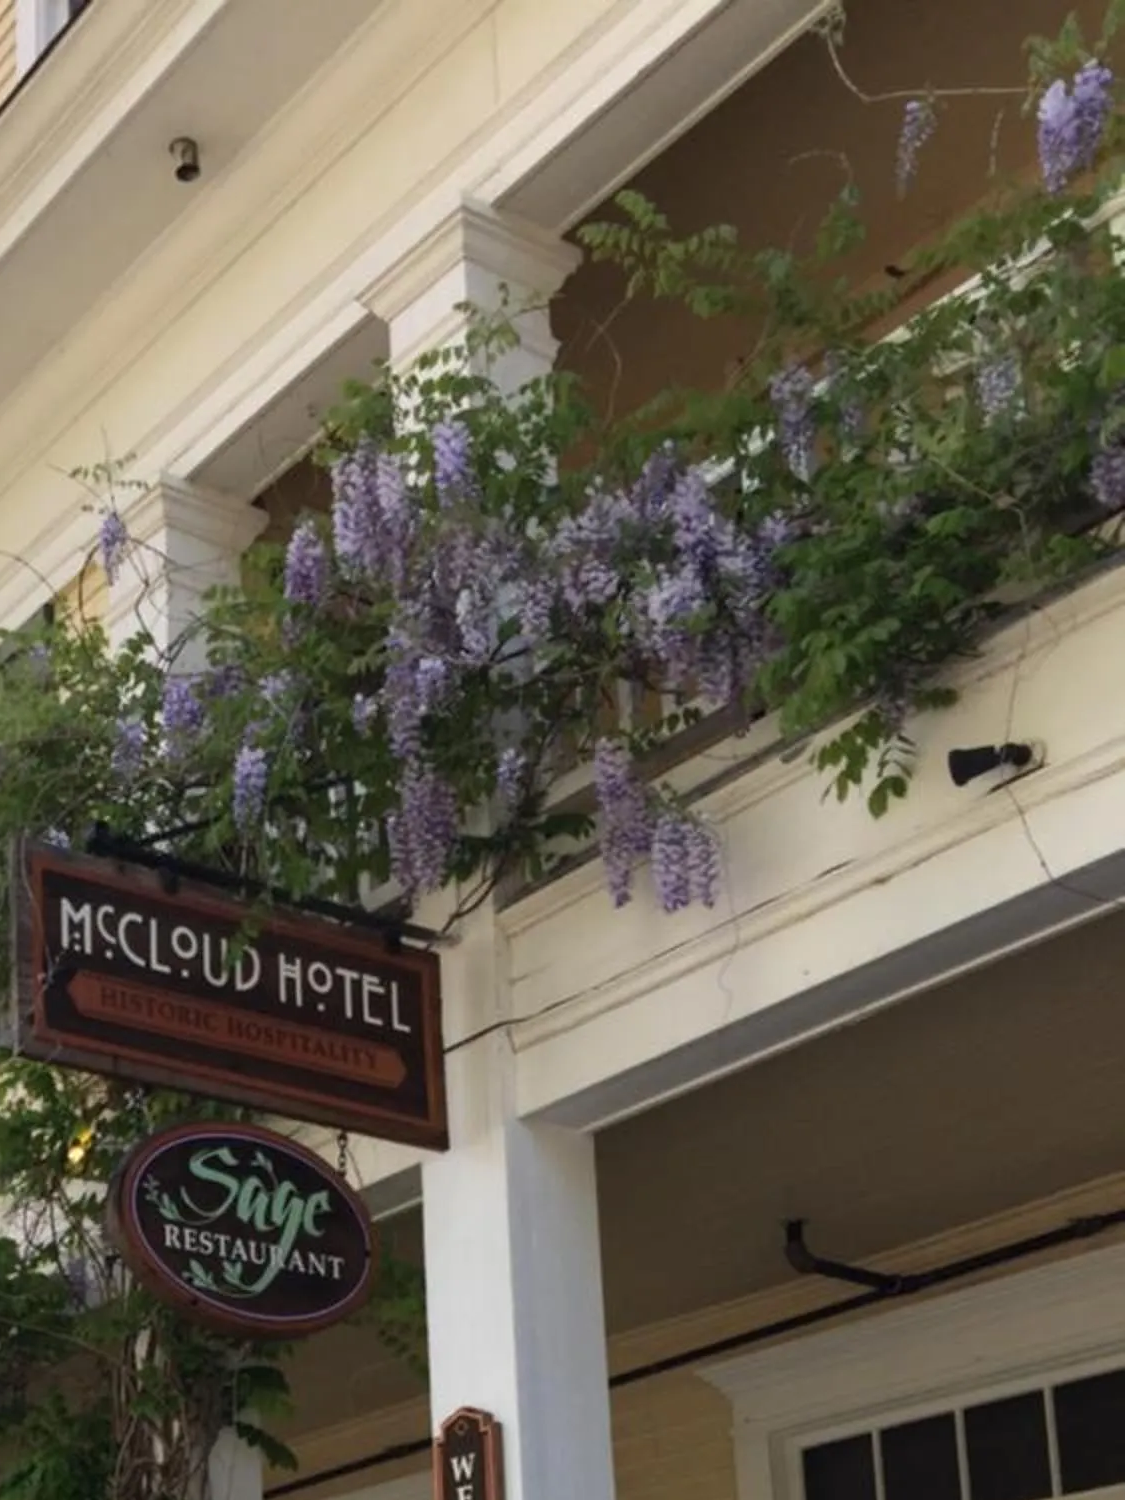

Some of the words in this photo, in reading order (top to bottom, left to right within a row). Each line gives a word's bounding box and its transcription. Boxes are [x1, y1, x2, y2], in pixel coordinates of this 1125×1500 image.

[101, 985, 220, 1033] HISTORIC
[227, 1017, 378, 1070] HOSPITALITY
[279, 951, 411, 1034] HOTEL
[163, 1224, 345, 1279] RESTAURANT
[180, 1147, 331, 1292] Sage
